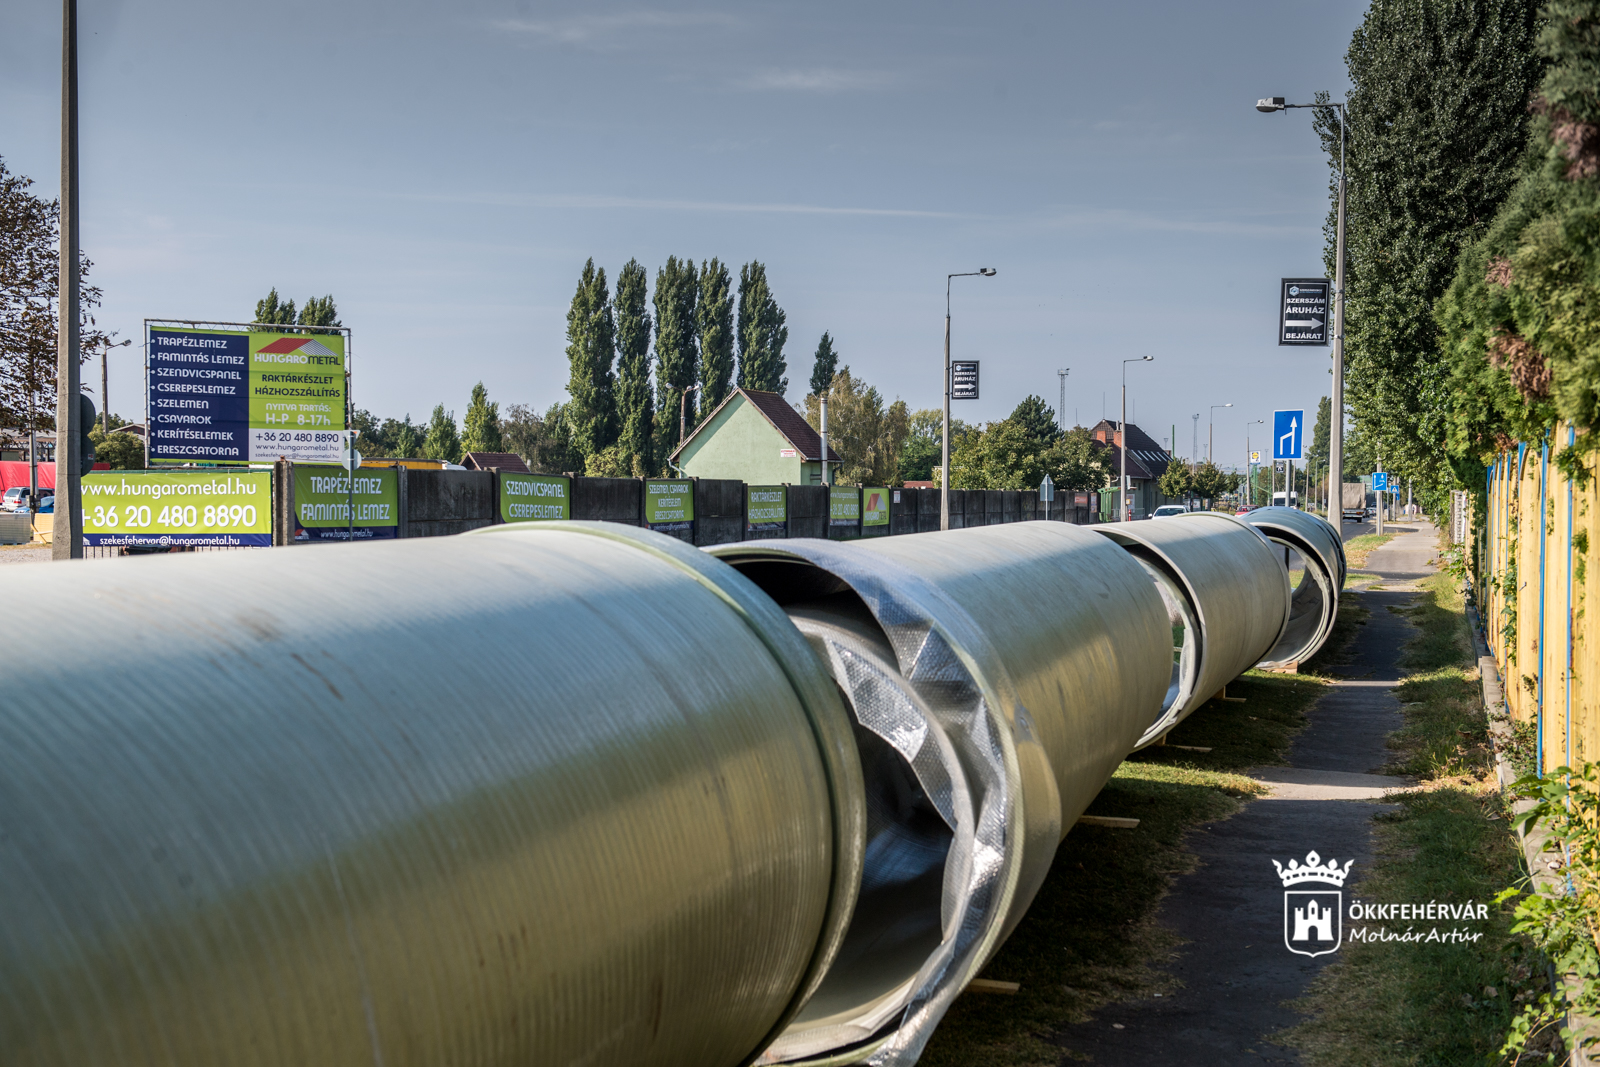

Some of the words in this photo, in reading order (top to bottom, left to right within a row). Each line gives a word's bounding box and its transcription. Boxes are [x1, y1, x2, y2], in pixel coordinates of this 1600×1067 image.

[157, 336, 227, 349] TRAPÉZLEMEZ
[157, 351, 209, 364] FAMINTÁS
[211, 354, 245, 365] LEMEZ
[254, 353, 341, 366] HUNGAROMETAL
[157, 367, 242, 380] SZENDVICSPANEL
[261, 373, 334, 385] RAKTÁRKÉSZLET
[157, 382, 236, 395] CSEREPESLEMEZ
[254, 386, 340, 398] HÁZHOZSZÁLLÍTÁS
[157, 398, 209, 409] SZELEMEN
[265, 402, 297, 411] NYITVA
[299, 403, 332, 412] TARTÁS:
[157, 414, 212, 425] CSAVAROK
[265, 413, 289, 424] H-P
[297, 414, 331, 426] 8-17h
[157, 427, 234, 441] KERÍTÉSELEMEK
[255, 432, 276, 441] +36
[279, 432, 291, 442] 20
[294, 433, 312, 442] 480
[315, 433, 339, 443] 8890
[157, 444, 239, 456] ERESZCSATORNA
[255, 443, 339, 452] www.hungarometal.hu
[310, 473, 382, 494] TRAPÉZEMEZ
[505, 480, 565, 498] SZENDVICSPANEL
[125, 505, 152, 527] 20
[157, 505, 197, 527] 480
[203, 505, 257, 527] 8890
[357, 503, 390, 520] LEMEZ
[508, 503, 563, 519] CSEREPESLEMEZ
[320, 528, 374, 540] www.hungaometal.hu
[99, 535, 240, 547] szekesfehervar@hungarometal.hu
